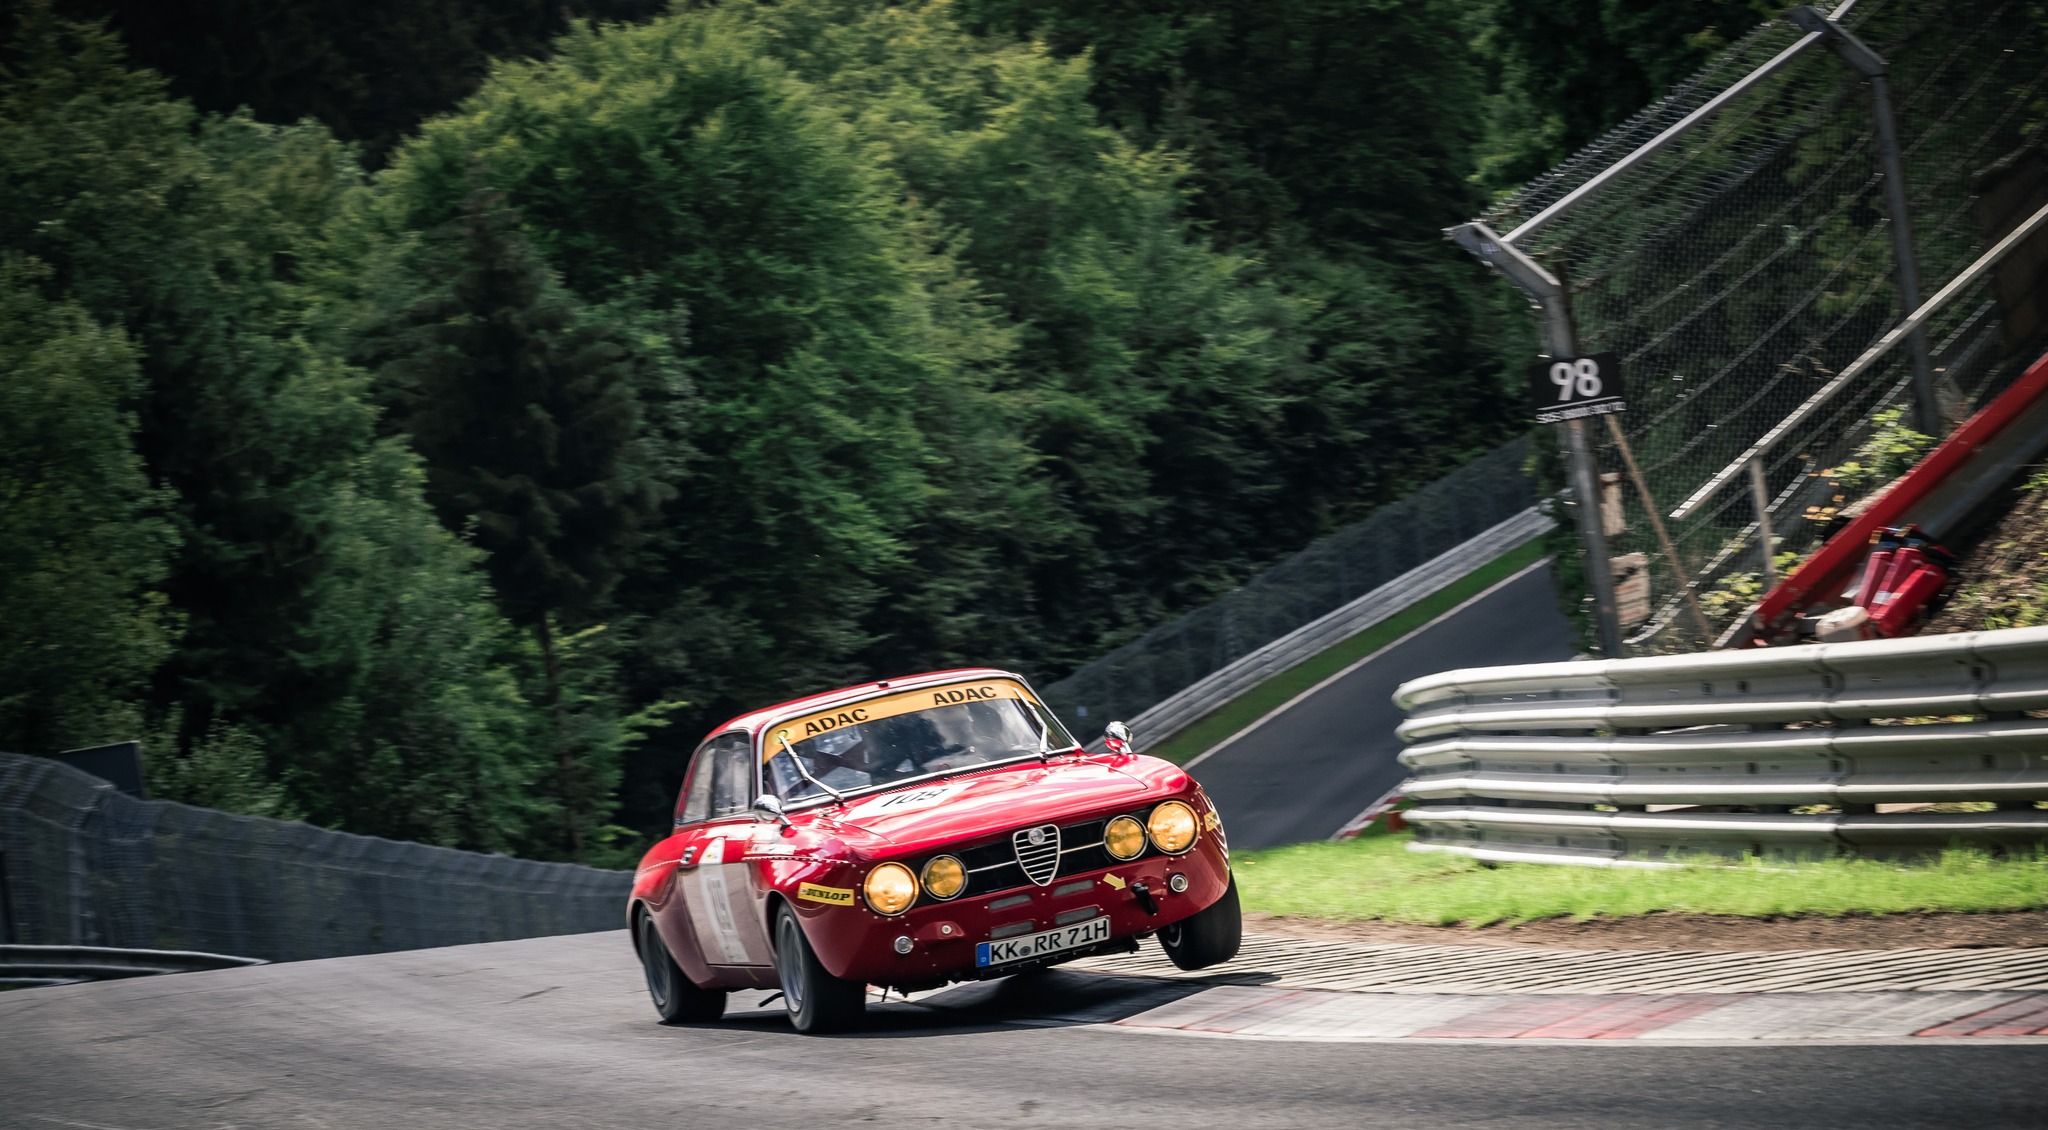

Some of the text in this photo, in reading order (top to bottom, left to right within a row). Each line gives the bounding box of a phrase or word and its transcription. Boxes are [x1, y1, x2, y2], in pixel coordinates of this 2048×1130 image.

[1549, 358, 1603, 401] 98
[932, 686, 997, 706] ADAC
[805, 708, 869, 736] ADAC
[805, 888, 850, 900] DUNLOP
[991, 921, 1107, 962] KK RR 71H
